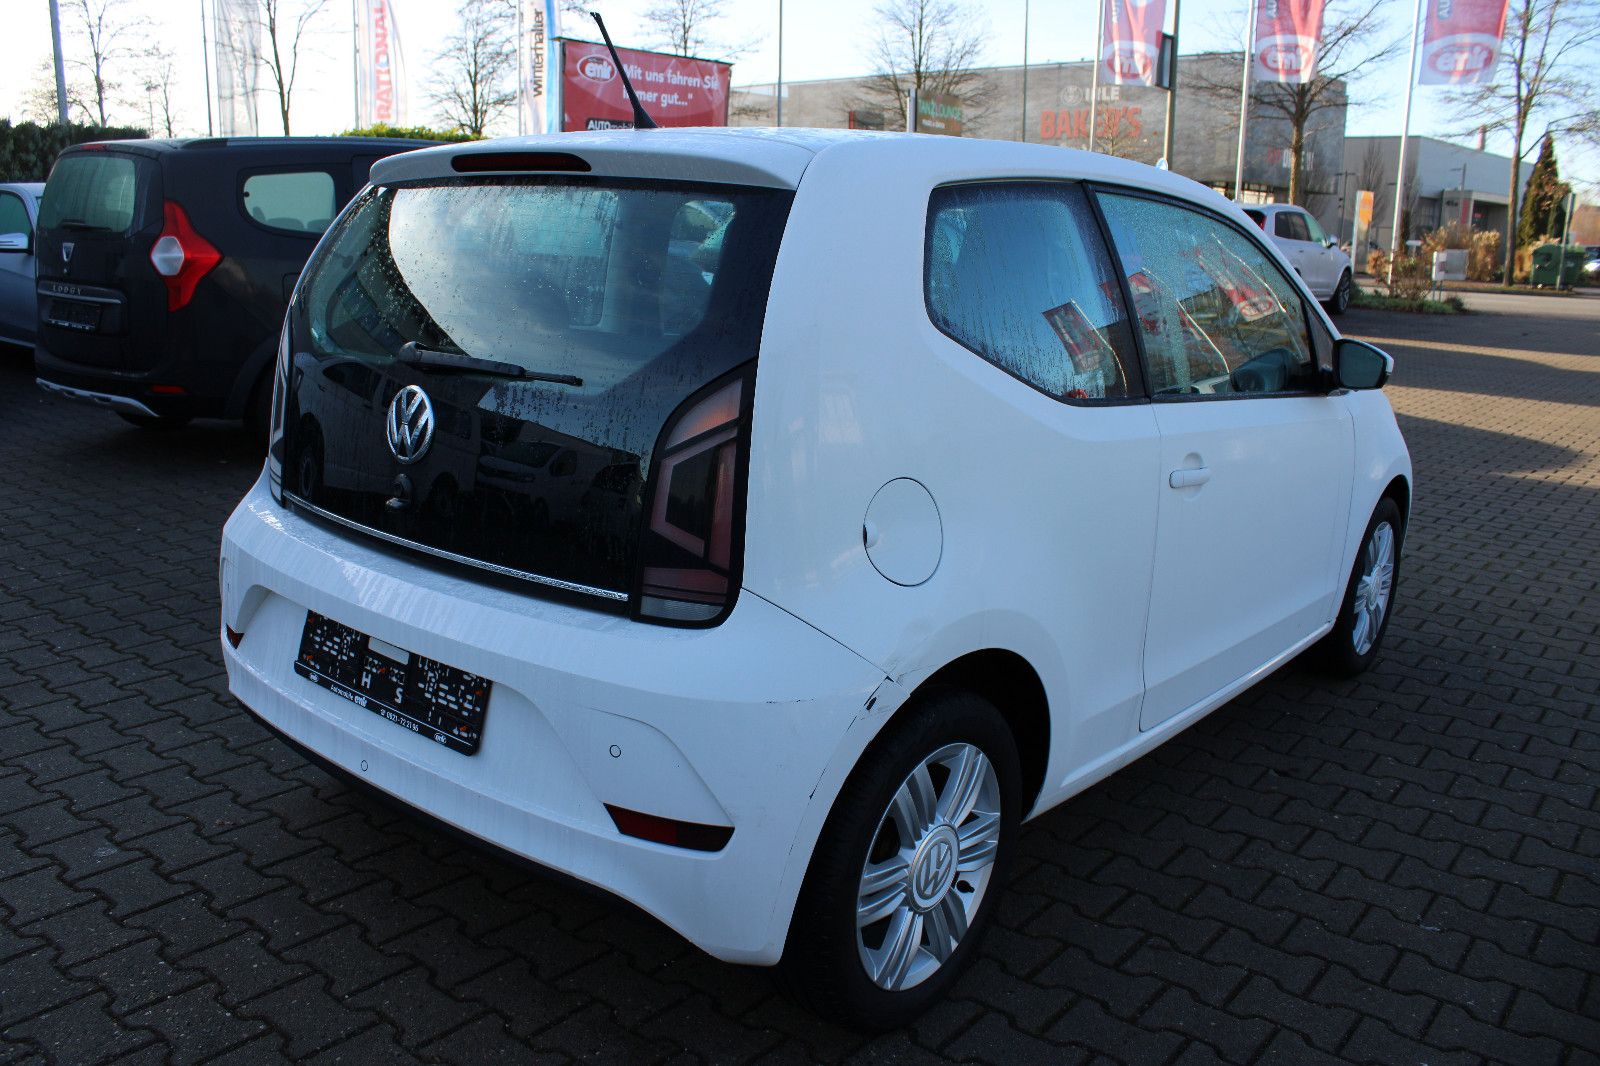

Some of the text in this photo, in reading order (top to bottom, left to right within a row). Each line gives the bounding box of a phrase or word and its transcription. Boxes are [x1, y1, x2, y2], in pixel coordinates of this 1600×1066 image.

[374, 0, 393, 119] RATIONAL
[531, 8, 545, 97] winterhalter
[645, 70, 664, 83] uns
[667, 69, 700, 87] fahren
[703, 75, 720, 89] Sie
